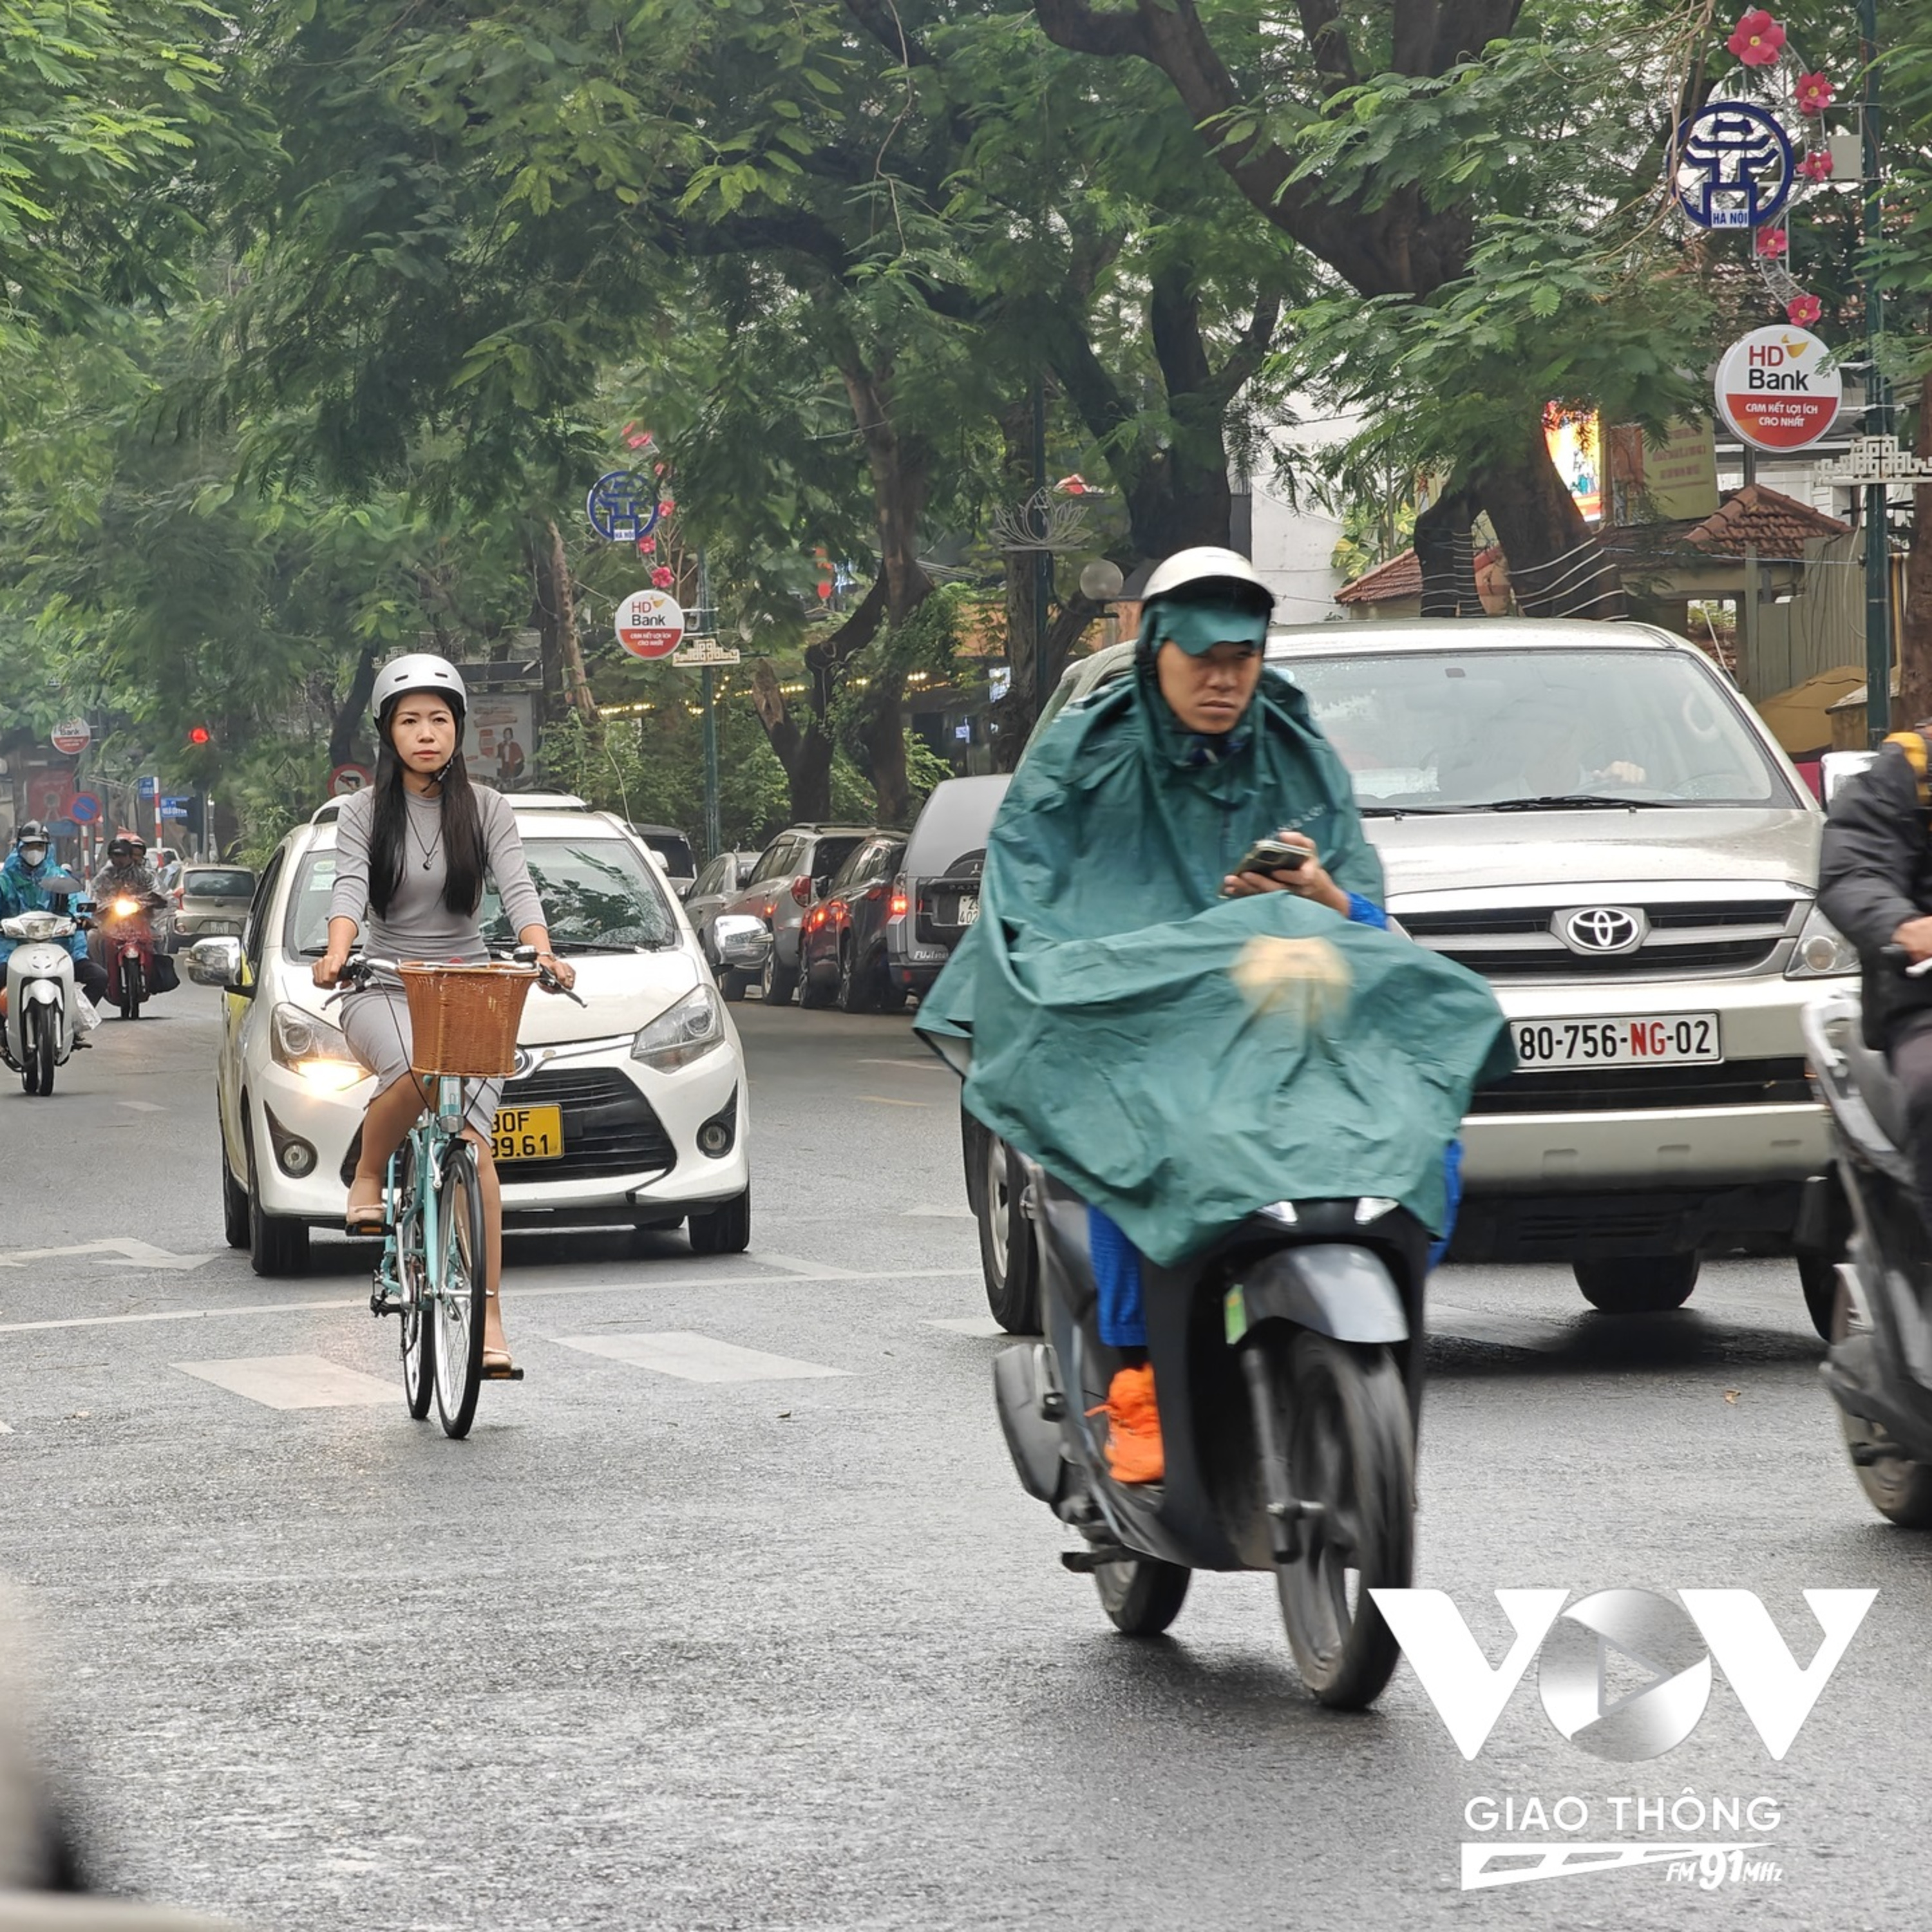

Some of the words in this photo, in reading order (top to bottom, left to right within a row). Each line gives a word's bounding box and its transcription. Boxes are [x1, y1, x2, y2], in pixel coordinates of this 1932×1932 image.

[1713, 210, 1727, 224] HÀ
[1730, 209, 1747, 227] NỘI
[1748, 345, 1784, 366] HD
[1748, 368, 1809, 391] Bank
[1745, 403, 1766, 413] CAM
[1768, 401, 1785, 413] KẾT
[1759, 417, 1779, 426] CAO
[632, 601, 652, 613] HD
[632, 614, 666, 626] Bank
[1519, 1020, 1711, 1061] 80-756-NG-02
